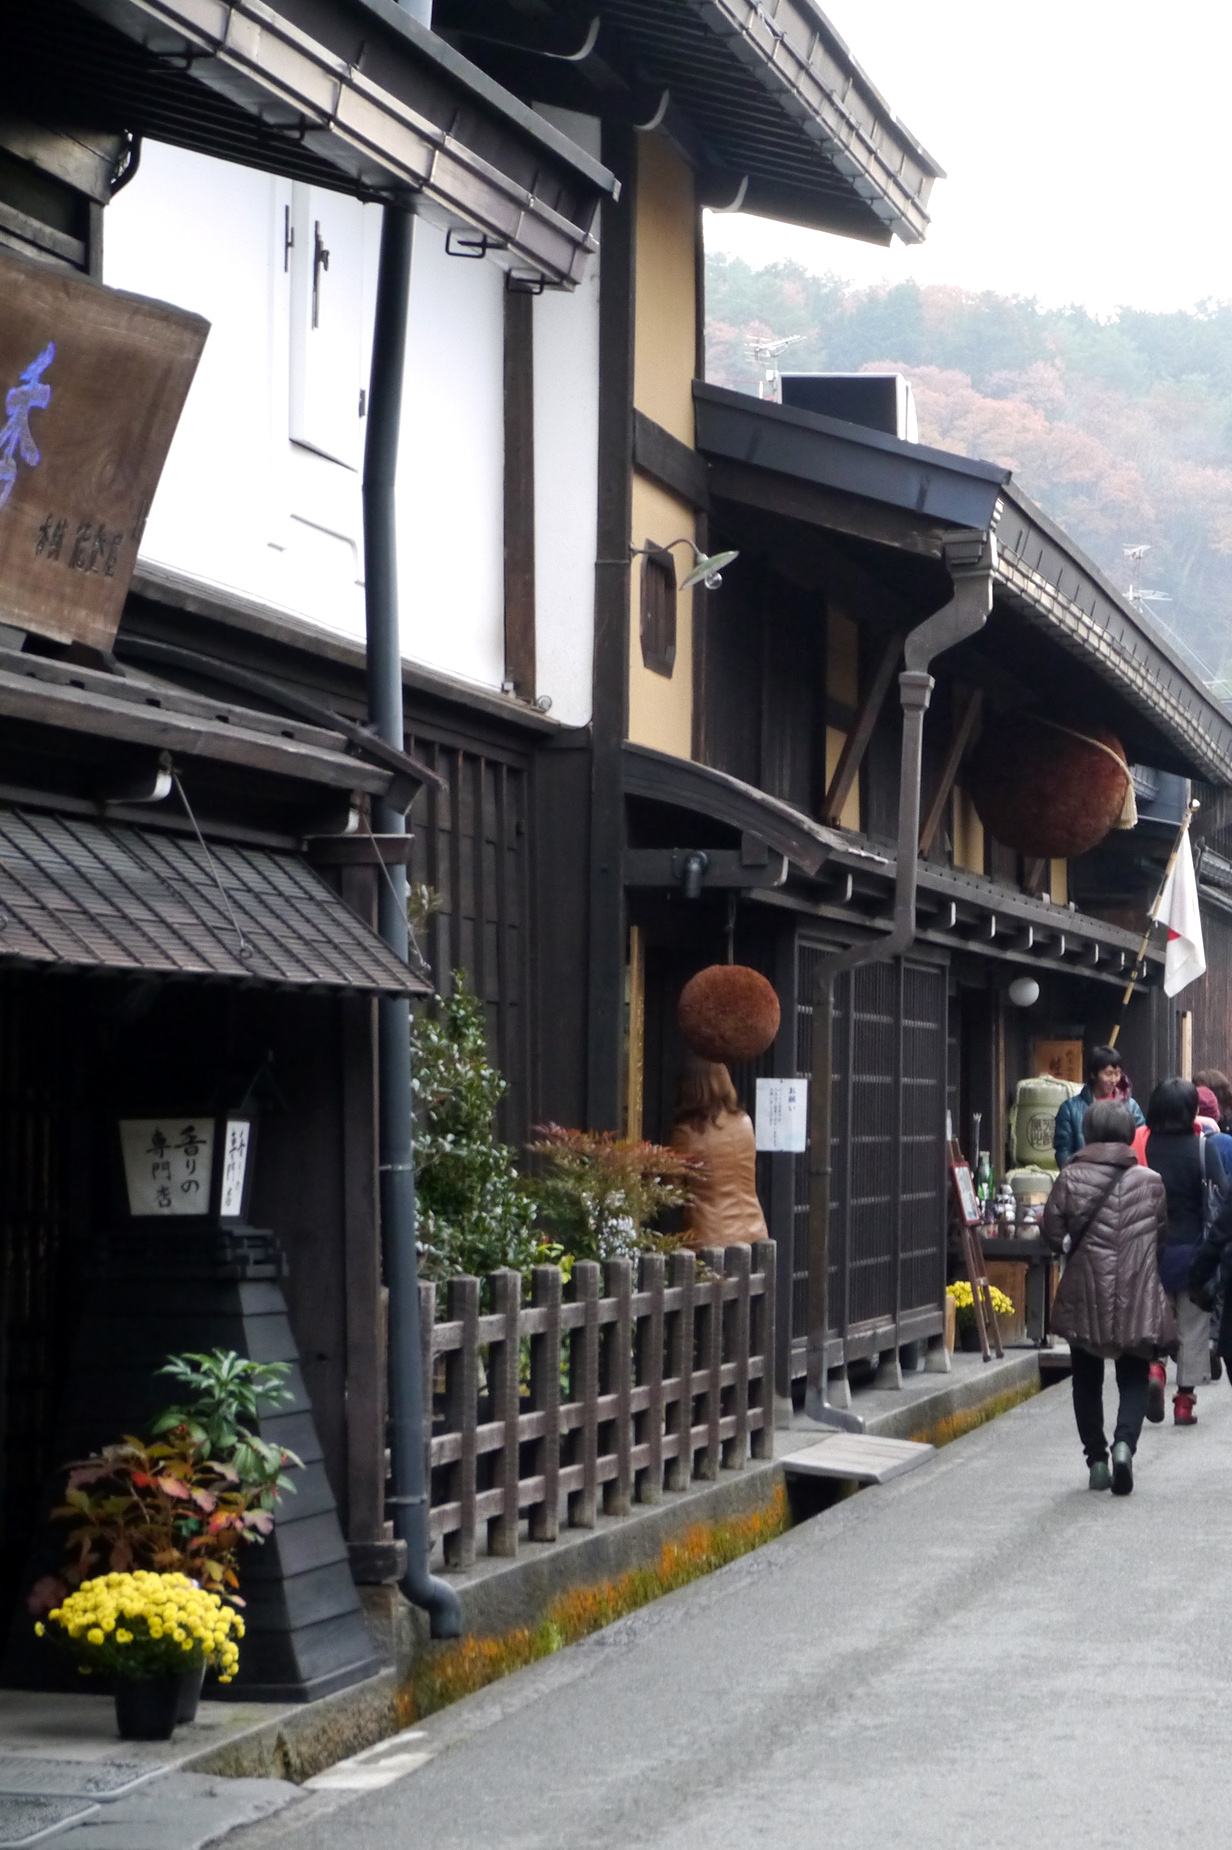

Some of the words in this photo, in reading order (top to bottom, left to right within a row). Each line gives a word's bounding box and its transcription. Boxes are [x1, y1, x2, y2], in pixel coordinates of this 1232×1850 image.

[788, 1087, 796, 1112] お願い
[175, 1125, 206, 1194] 香りの
